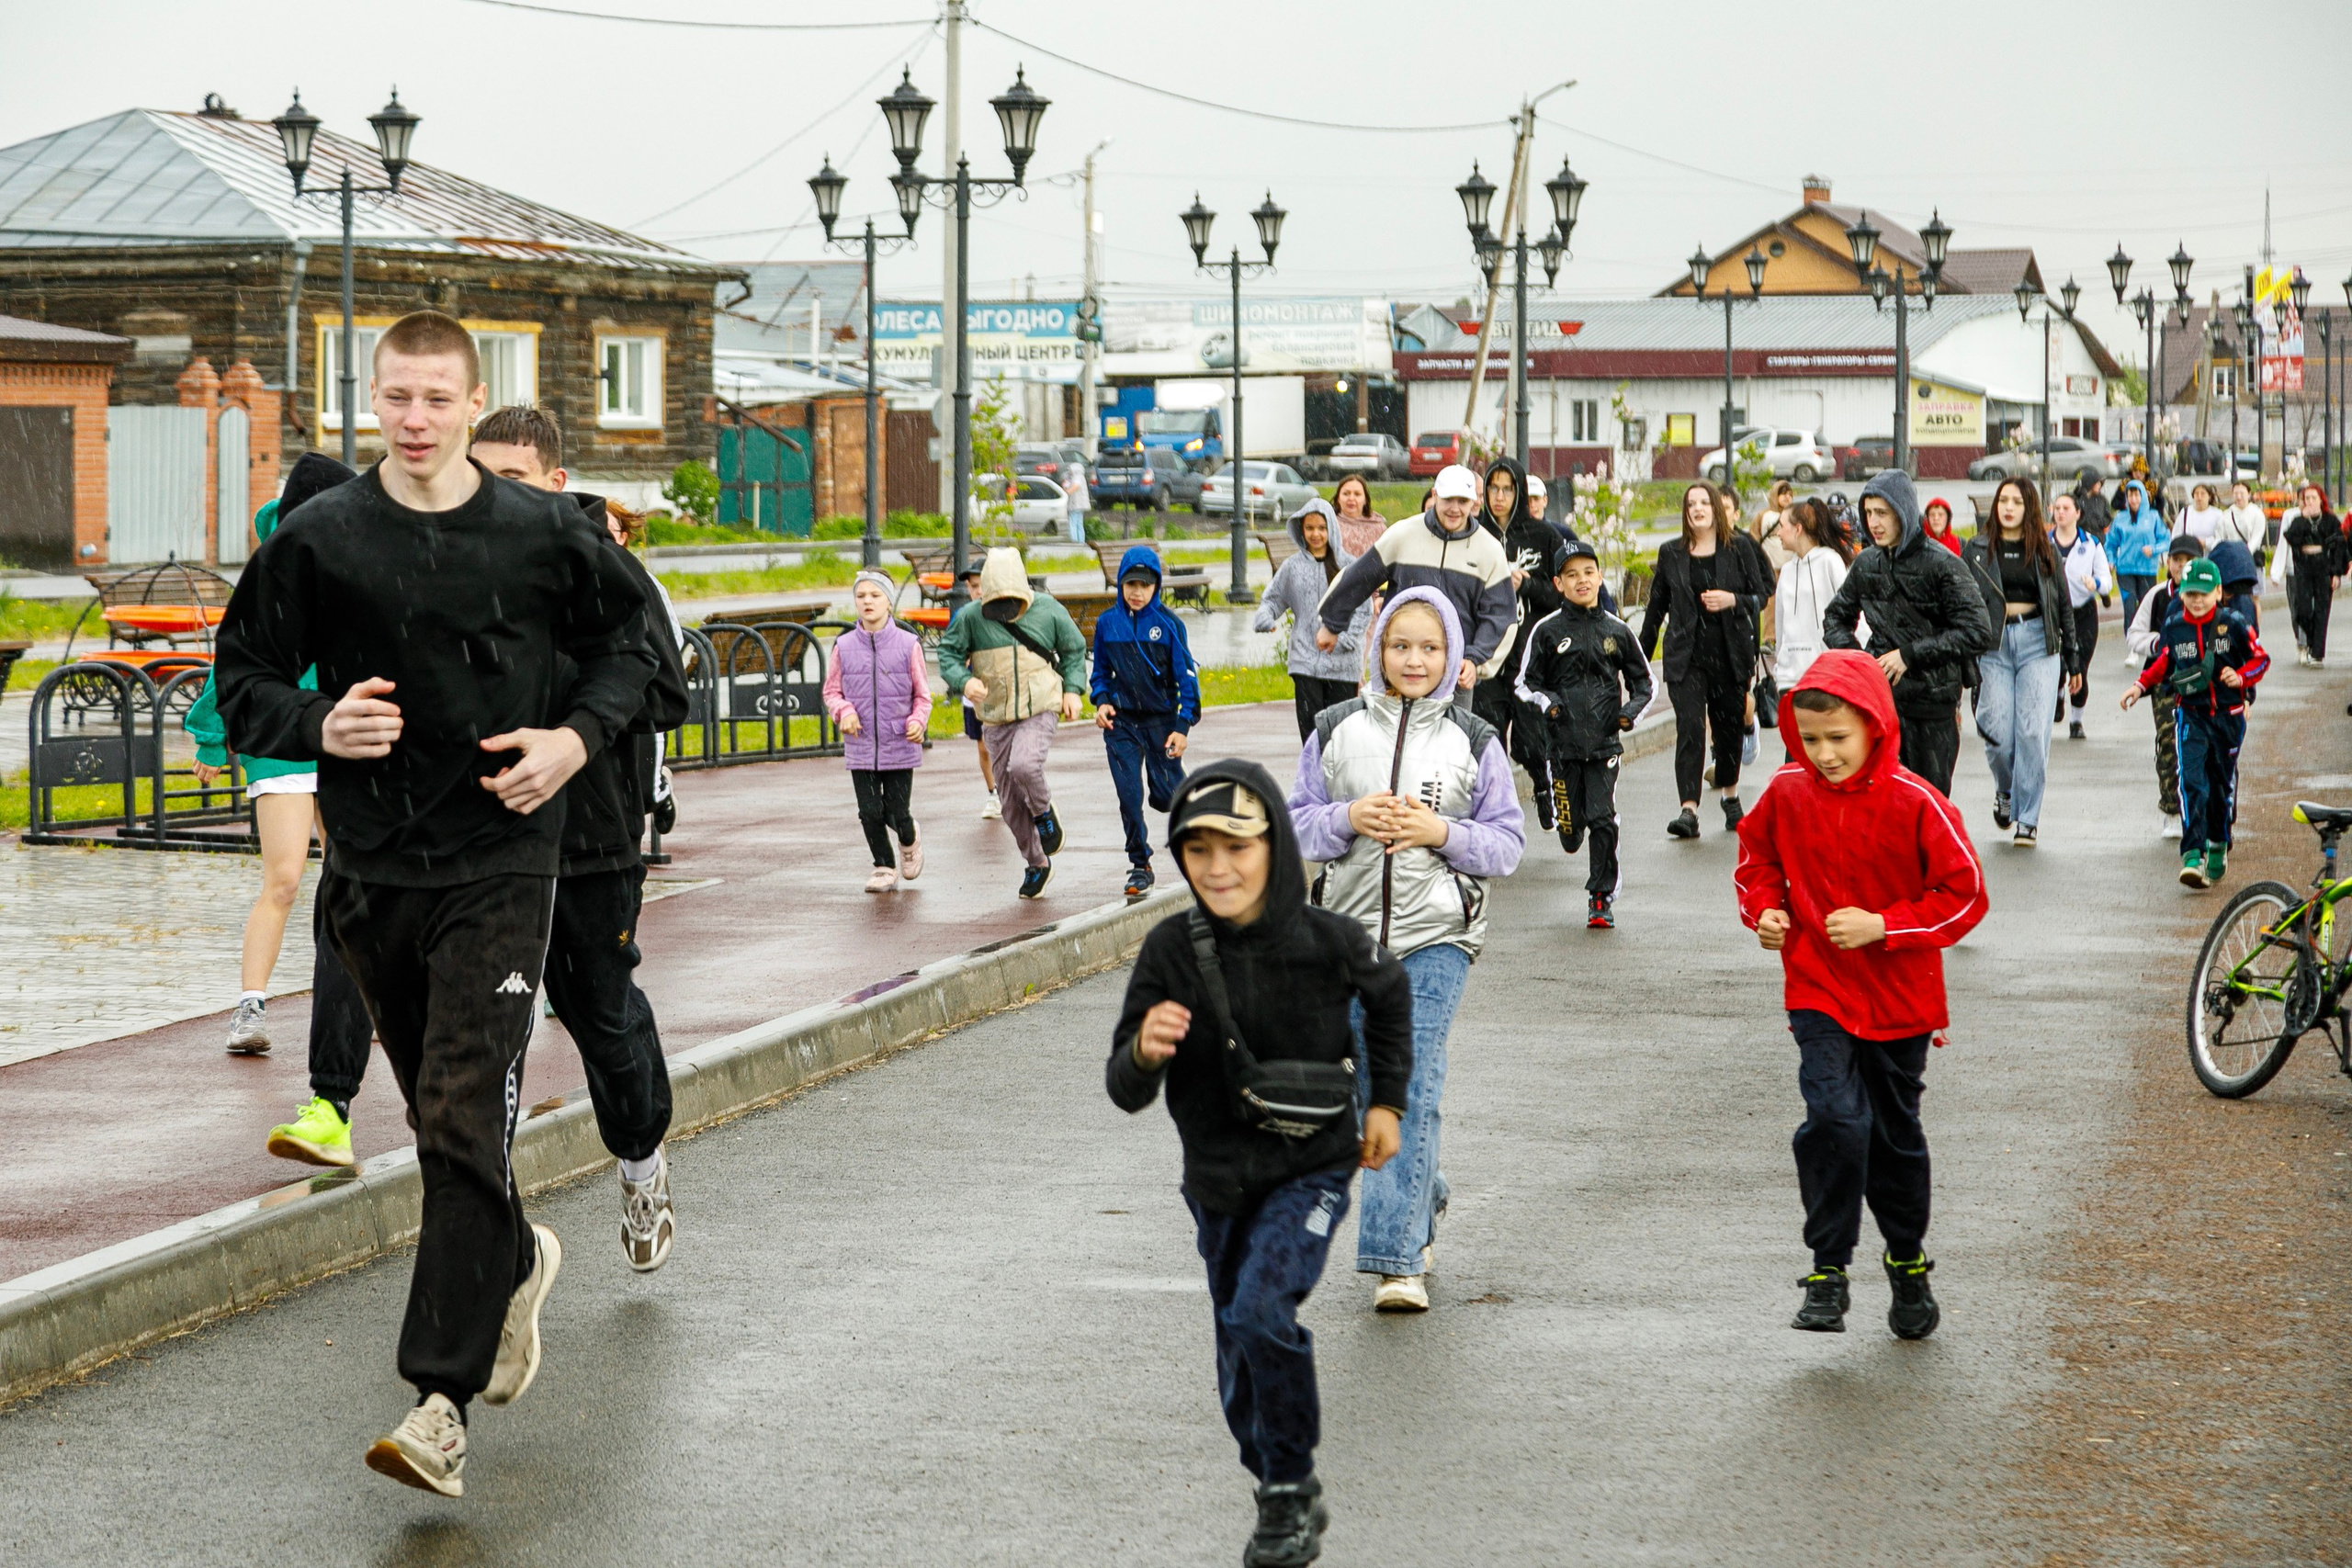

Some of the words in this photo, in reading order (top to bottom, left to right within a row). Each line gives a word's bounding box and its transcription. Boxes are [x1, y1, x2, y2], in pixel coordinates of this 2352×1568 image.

[875, 310, 943, 332] ЛЕСА
[967, 308, 1064, 332] ЫГОДНО
[1489, 321, 1562, 337] ВТГИД
[875, 343, 1012, 361] КУМУЛНЫЙ
[1016, 344, 1071, 364] ЦЕНТР
[1917, 401, 1974, 412] ЗАПРАВКА
[1926, 413, 1962, 424] АВТО
